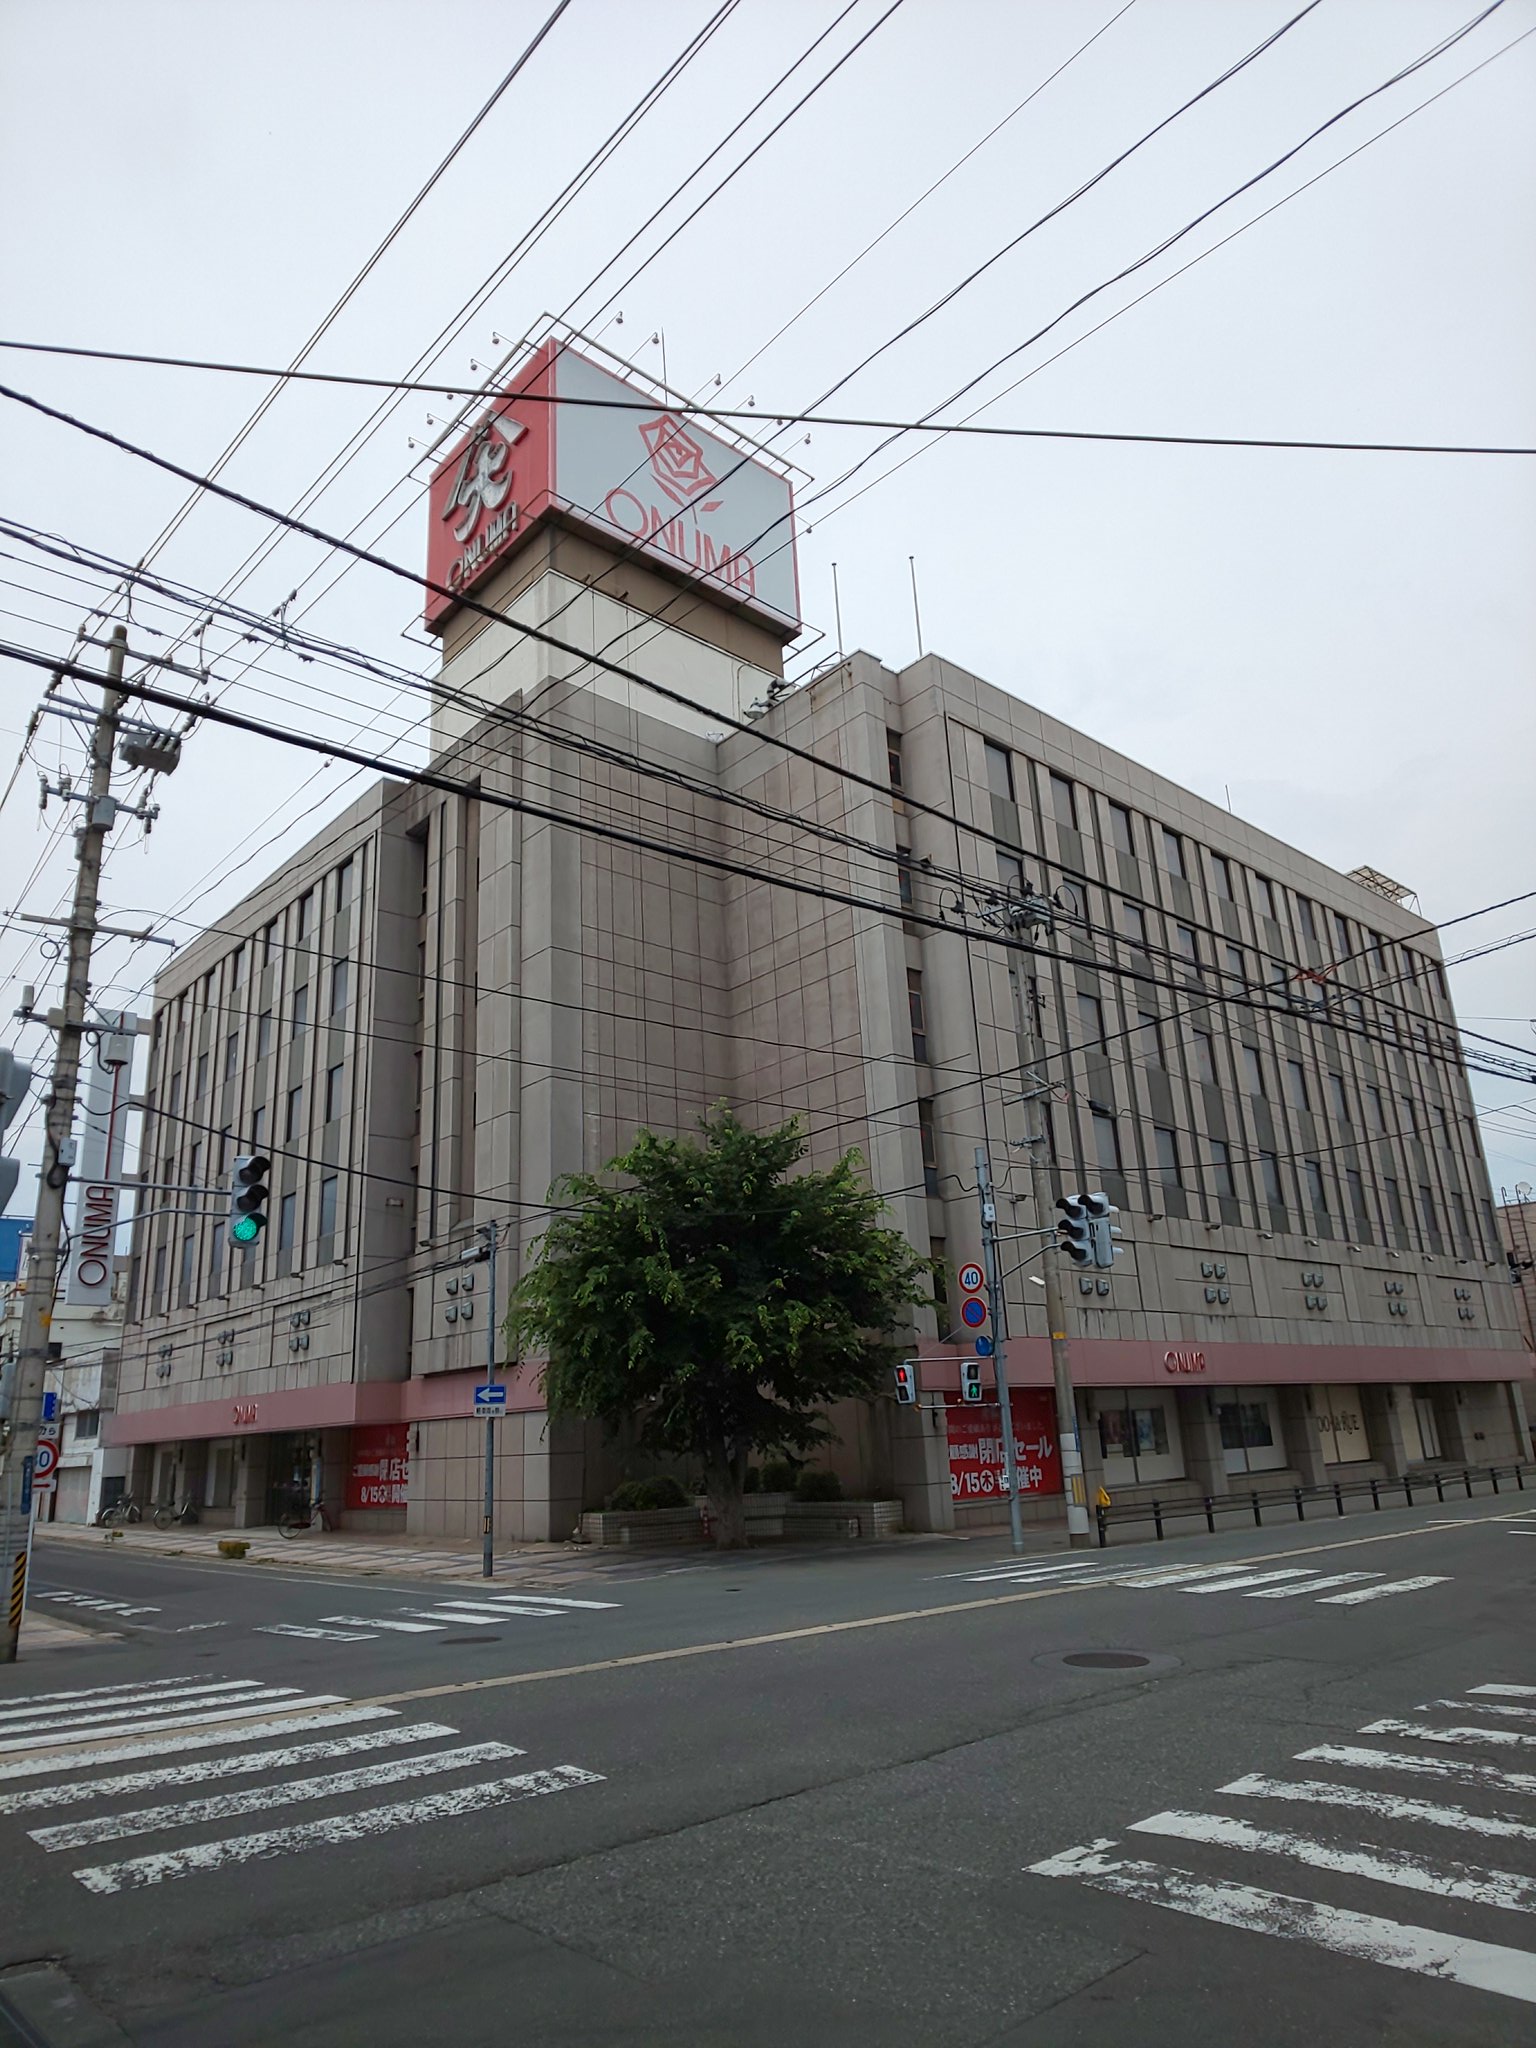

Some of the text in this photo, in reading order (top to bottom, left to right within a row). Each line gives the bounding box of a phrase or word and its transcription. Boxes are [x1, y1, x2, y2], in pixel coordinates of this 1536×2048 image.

[445, 500, 520, 593] ONUMA
[605, 487, 756, 597] ONUMA
[78, 1185, 115, 1287] ONUMA
[964, 1271, 978, 1286] 40
[1163, 1351, 1206, 1374] ONUMA
